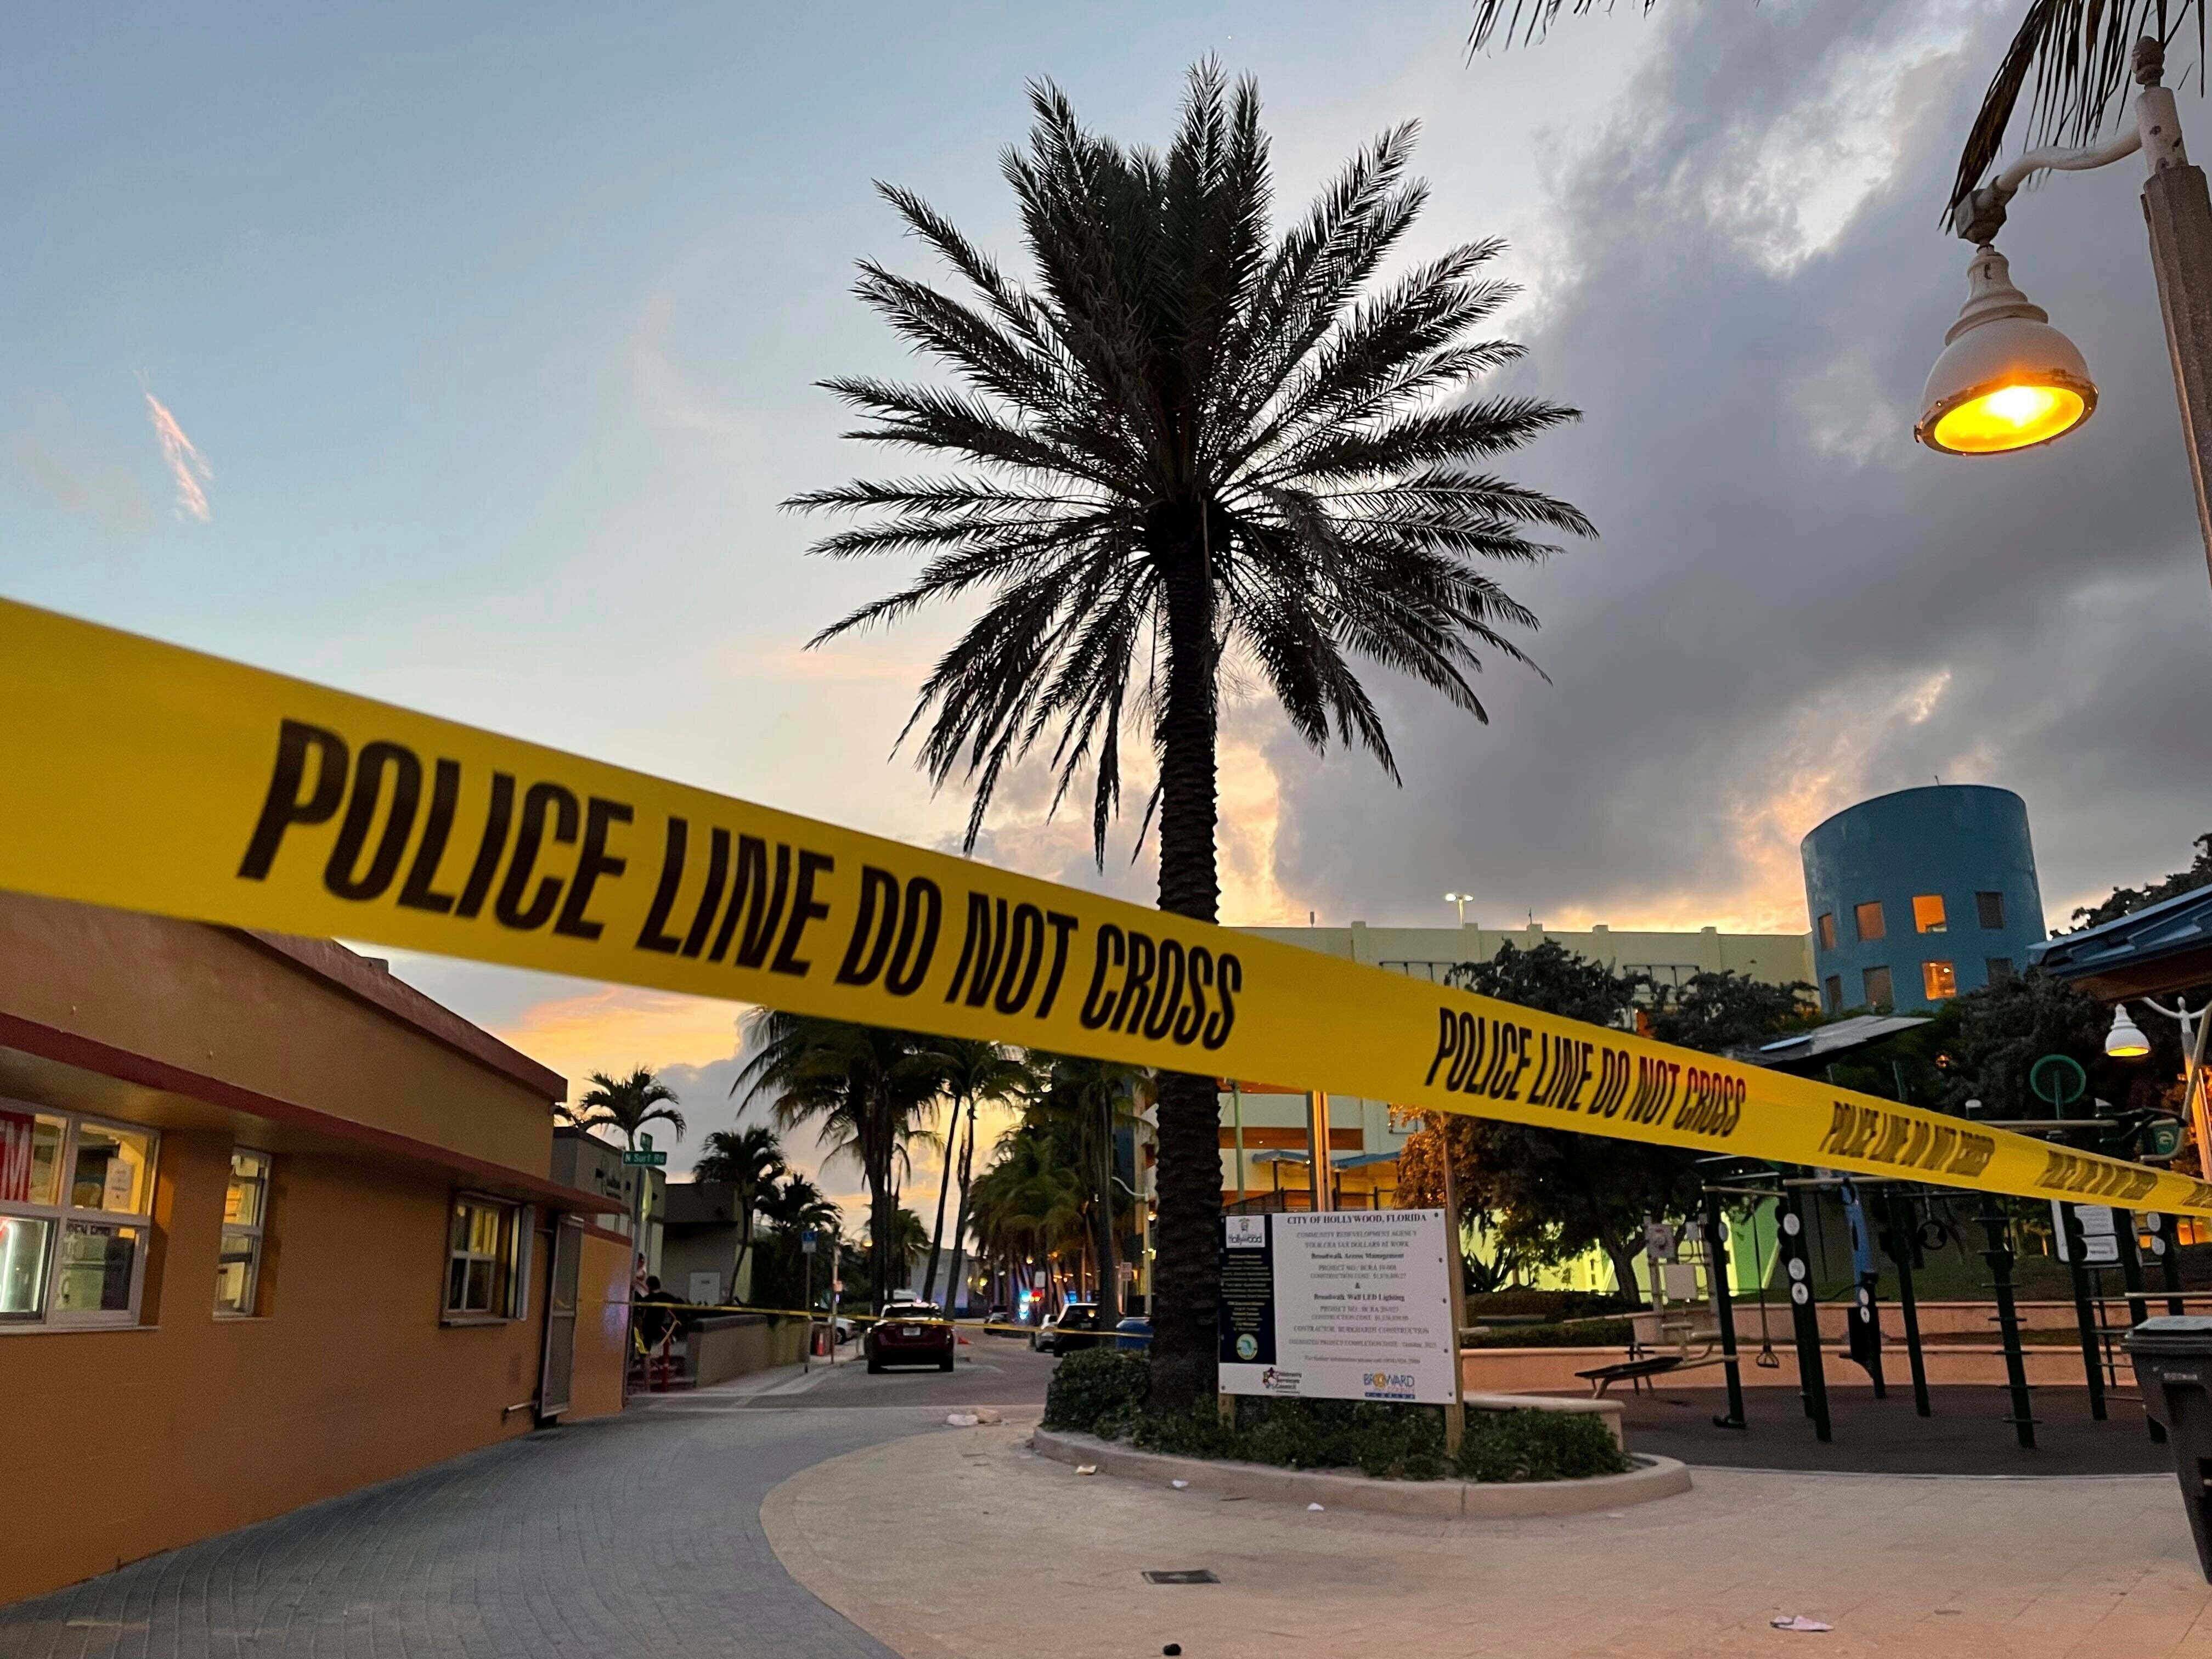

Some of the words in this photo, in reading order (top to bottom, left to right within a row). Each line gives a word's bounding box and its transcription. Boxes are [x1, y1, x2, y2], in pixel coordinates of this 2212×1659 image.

[236, 717, 635, 943] POLICE
[635, 816, 836, 979] LINE
[834, 864, 944, 997] DO
[944, 889, 1080, 1020] NOT
[1077, 922, 1243, 1052] CROSS
[1424, 1007, 1532, 1102] POLICE
[1525, 1032, 1594, 1111] LINE
[1586, 1047, 1630, 1119] DO
[1623, 1056, 1681, 1126] NOT
[1672, 1066, 1746, 1138] CROSS
[625, 1153, 631, 1162] N
[634, 1153, 651, 1163] Surf
[654, 1153, 664, 1163] Rd
[1287, 1216, 1307, 1224] CITY
[1323, 1215, 1385, 1223] HOLLYWOOD,
[1386, 1213, 1427, 1222] FLORIDA
[1379, 1294, 1405, 1302] Lighting
